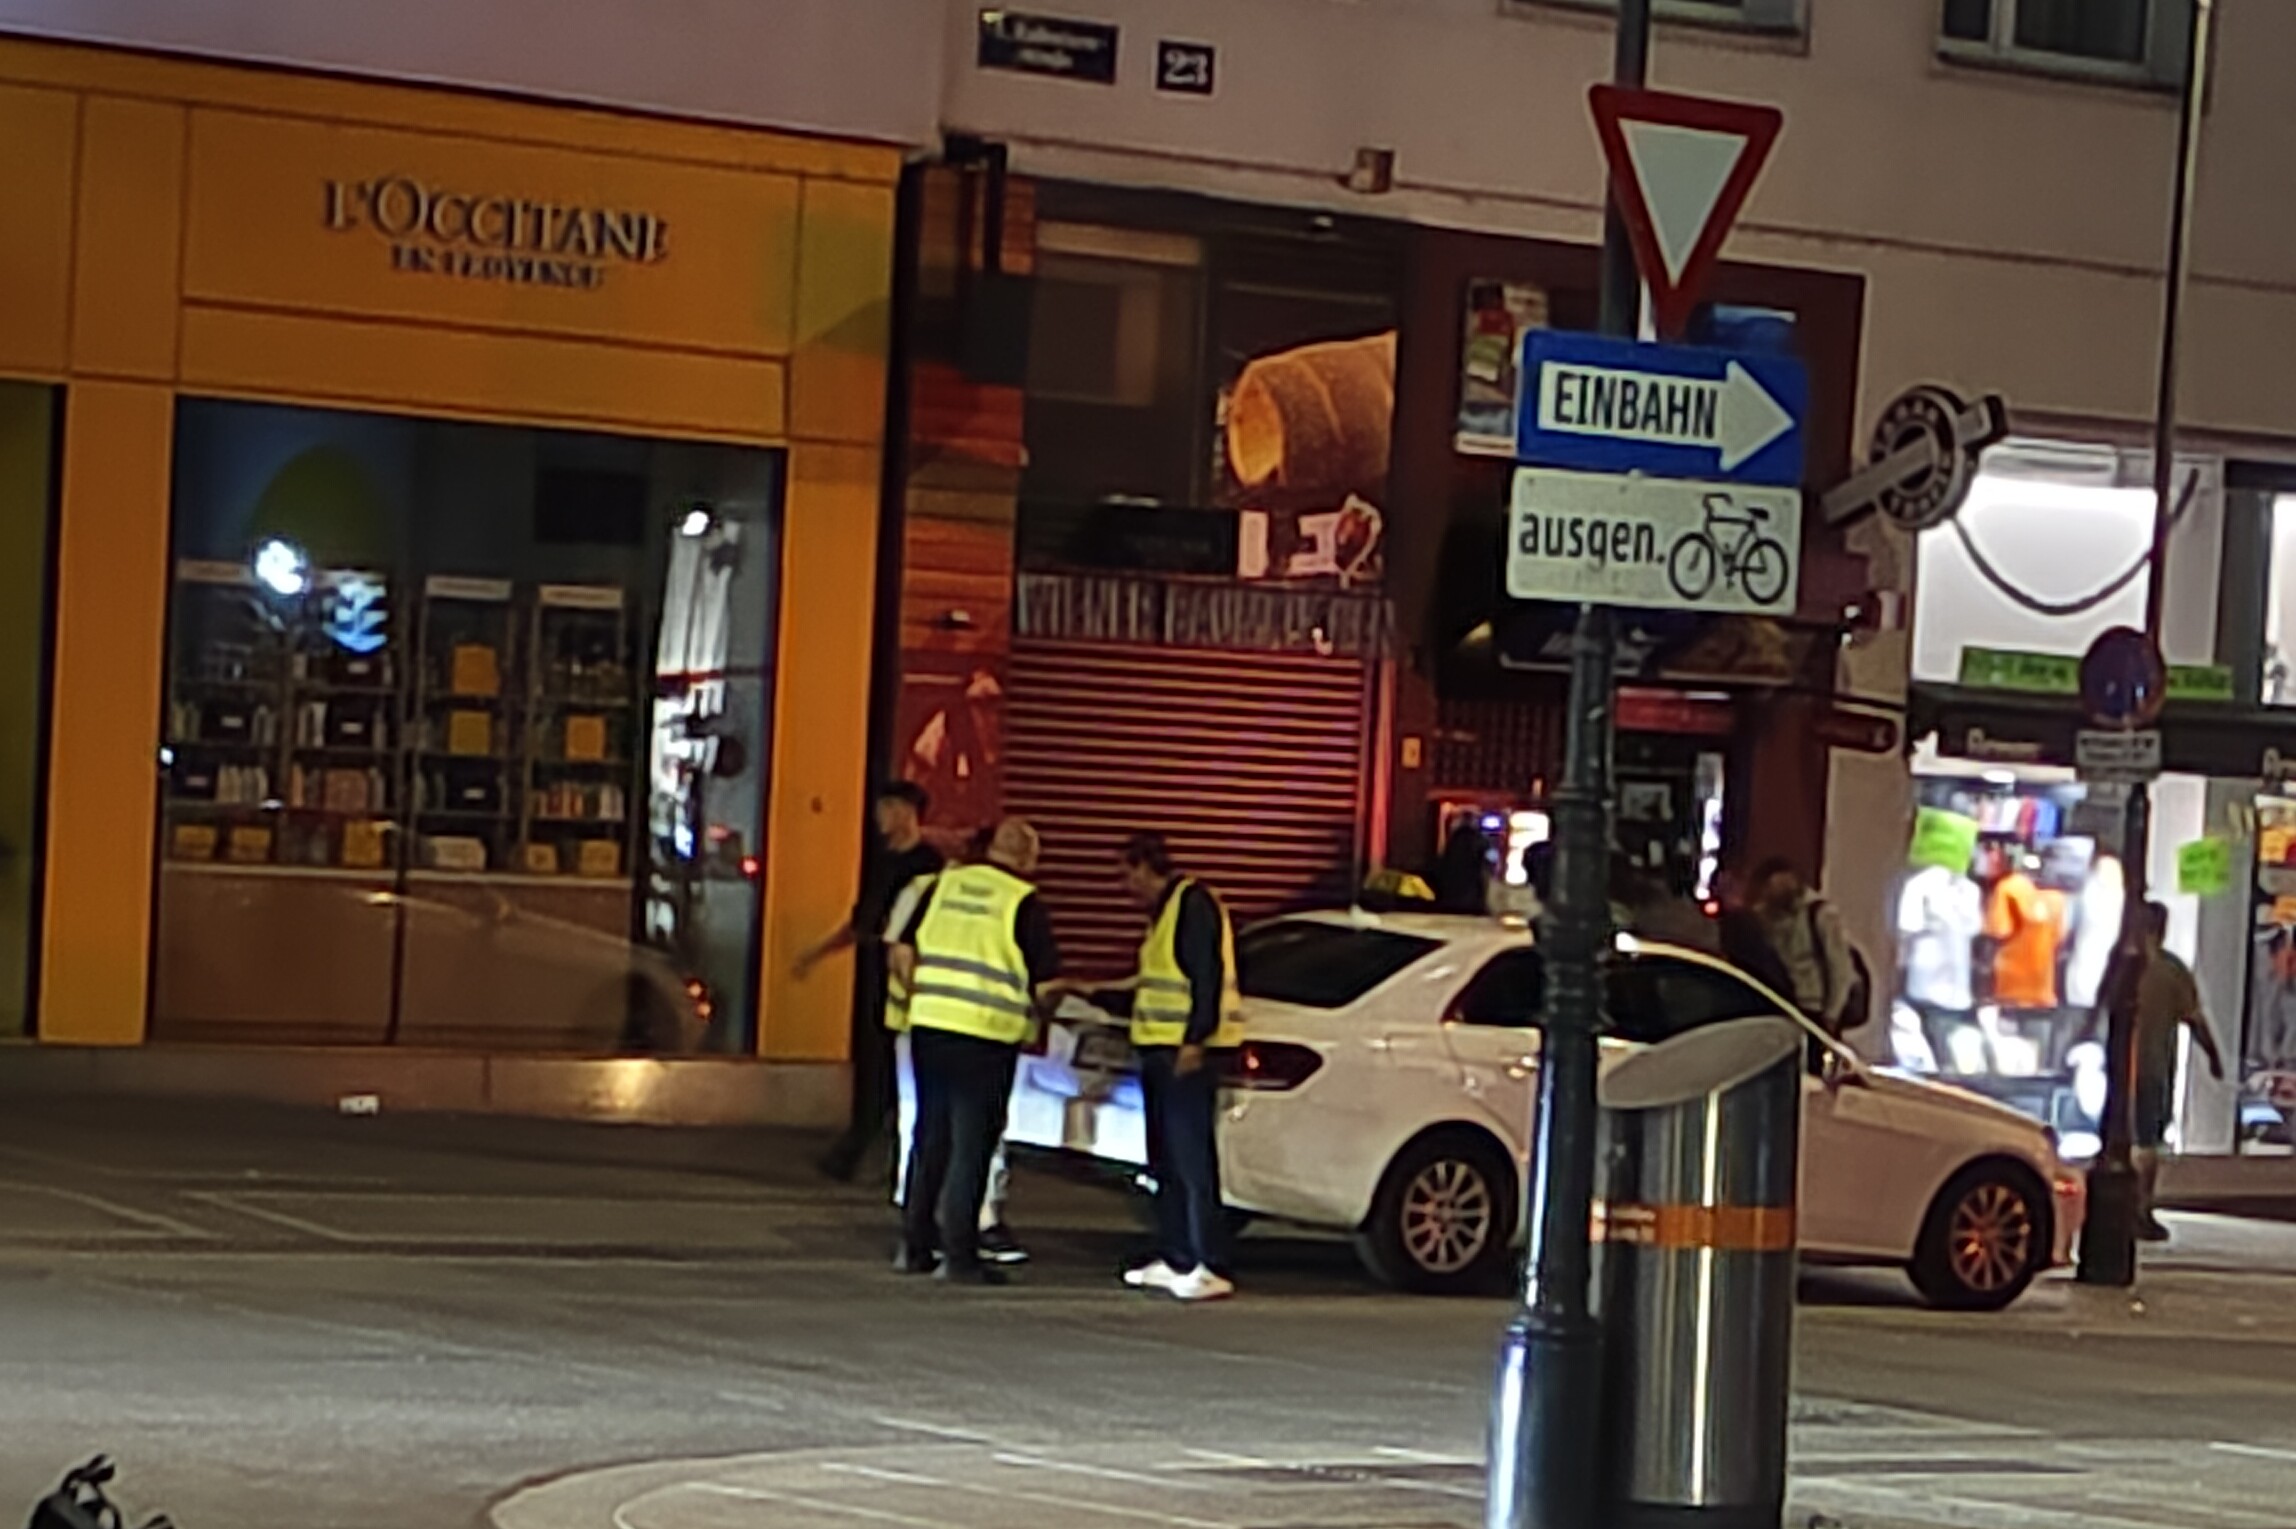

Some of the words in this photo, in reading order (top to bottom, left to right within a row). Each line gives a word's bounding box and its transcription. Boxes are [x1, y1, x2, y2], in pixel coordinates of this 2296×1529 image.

[1163, 50, 1208, 86] 23
[1553, 370, 1718, 439] EINBAHN
[1519, 512, 1667, 570] ausgen.
